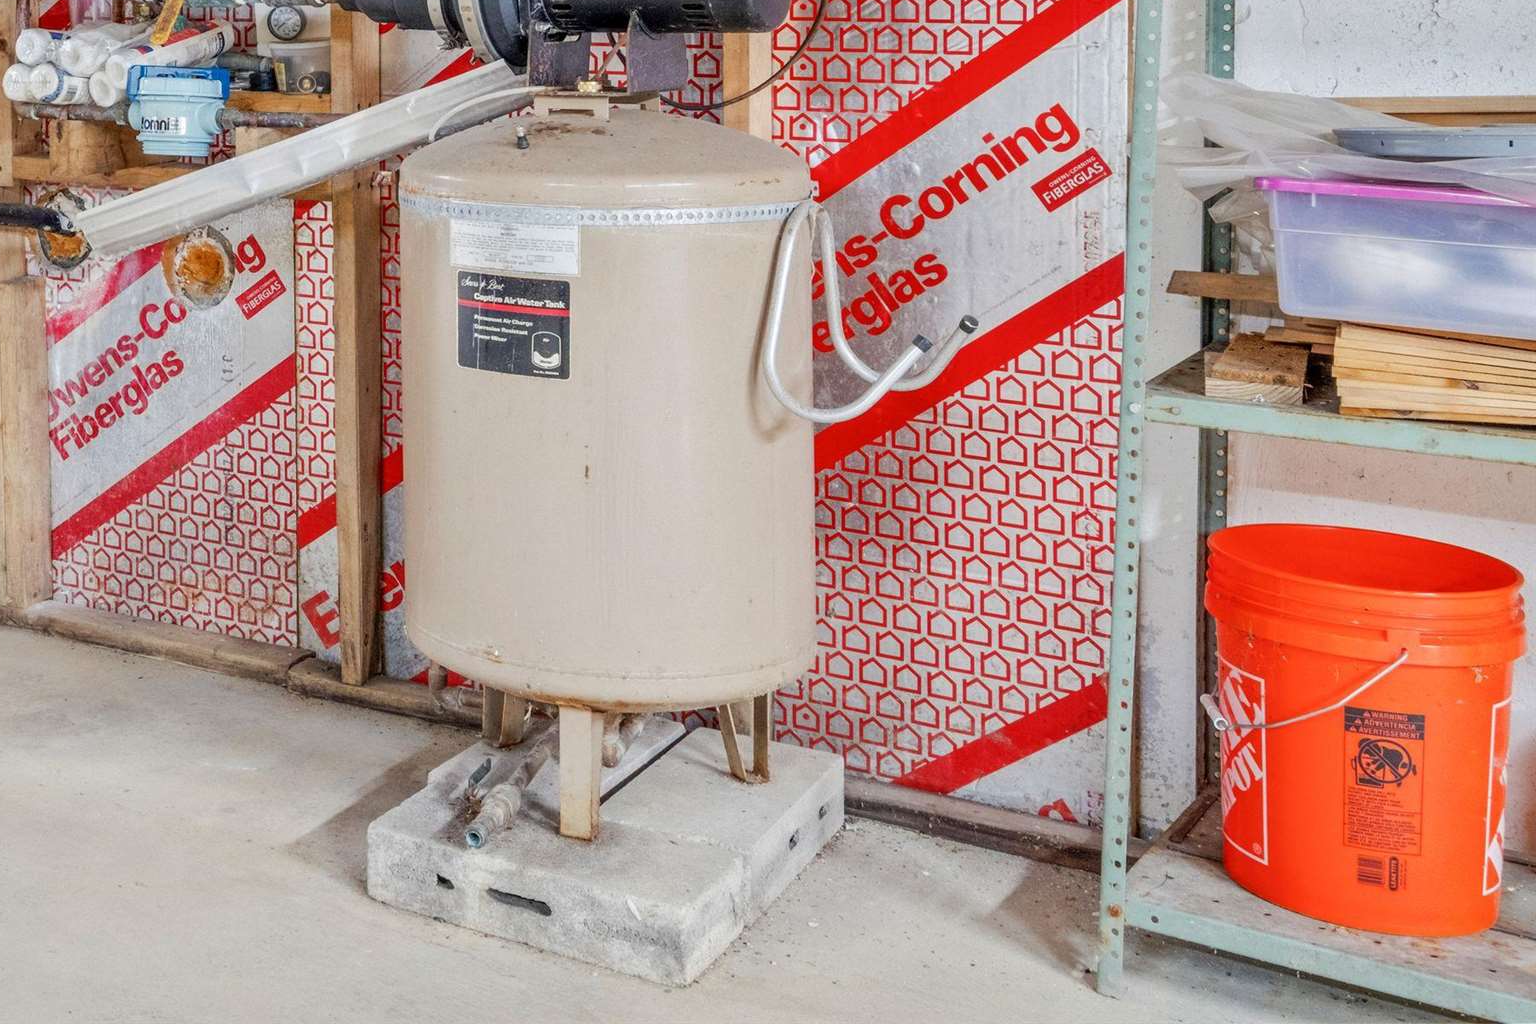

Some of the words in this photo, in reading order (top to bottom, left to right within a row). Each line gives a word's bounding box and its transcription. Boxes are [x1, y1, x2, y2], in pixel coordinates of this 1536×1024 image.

[1042, 161, 1104, 204] FIBERGLAS
[243, 280, 282, 314] FIBERGLAS
[503, 296, 517, 305] Air
[517, 297, 544, 307] Water
[544, 300, 566, 309] Tank
[49, 349, 185, 461] Fiberglas
[1371, 711, 1408, 722] WARNING
[1365, 718, 1417, 731] ADVERTENCIA
[1358, 726, 1421, 739] AVERTISSEMENT
